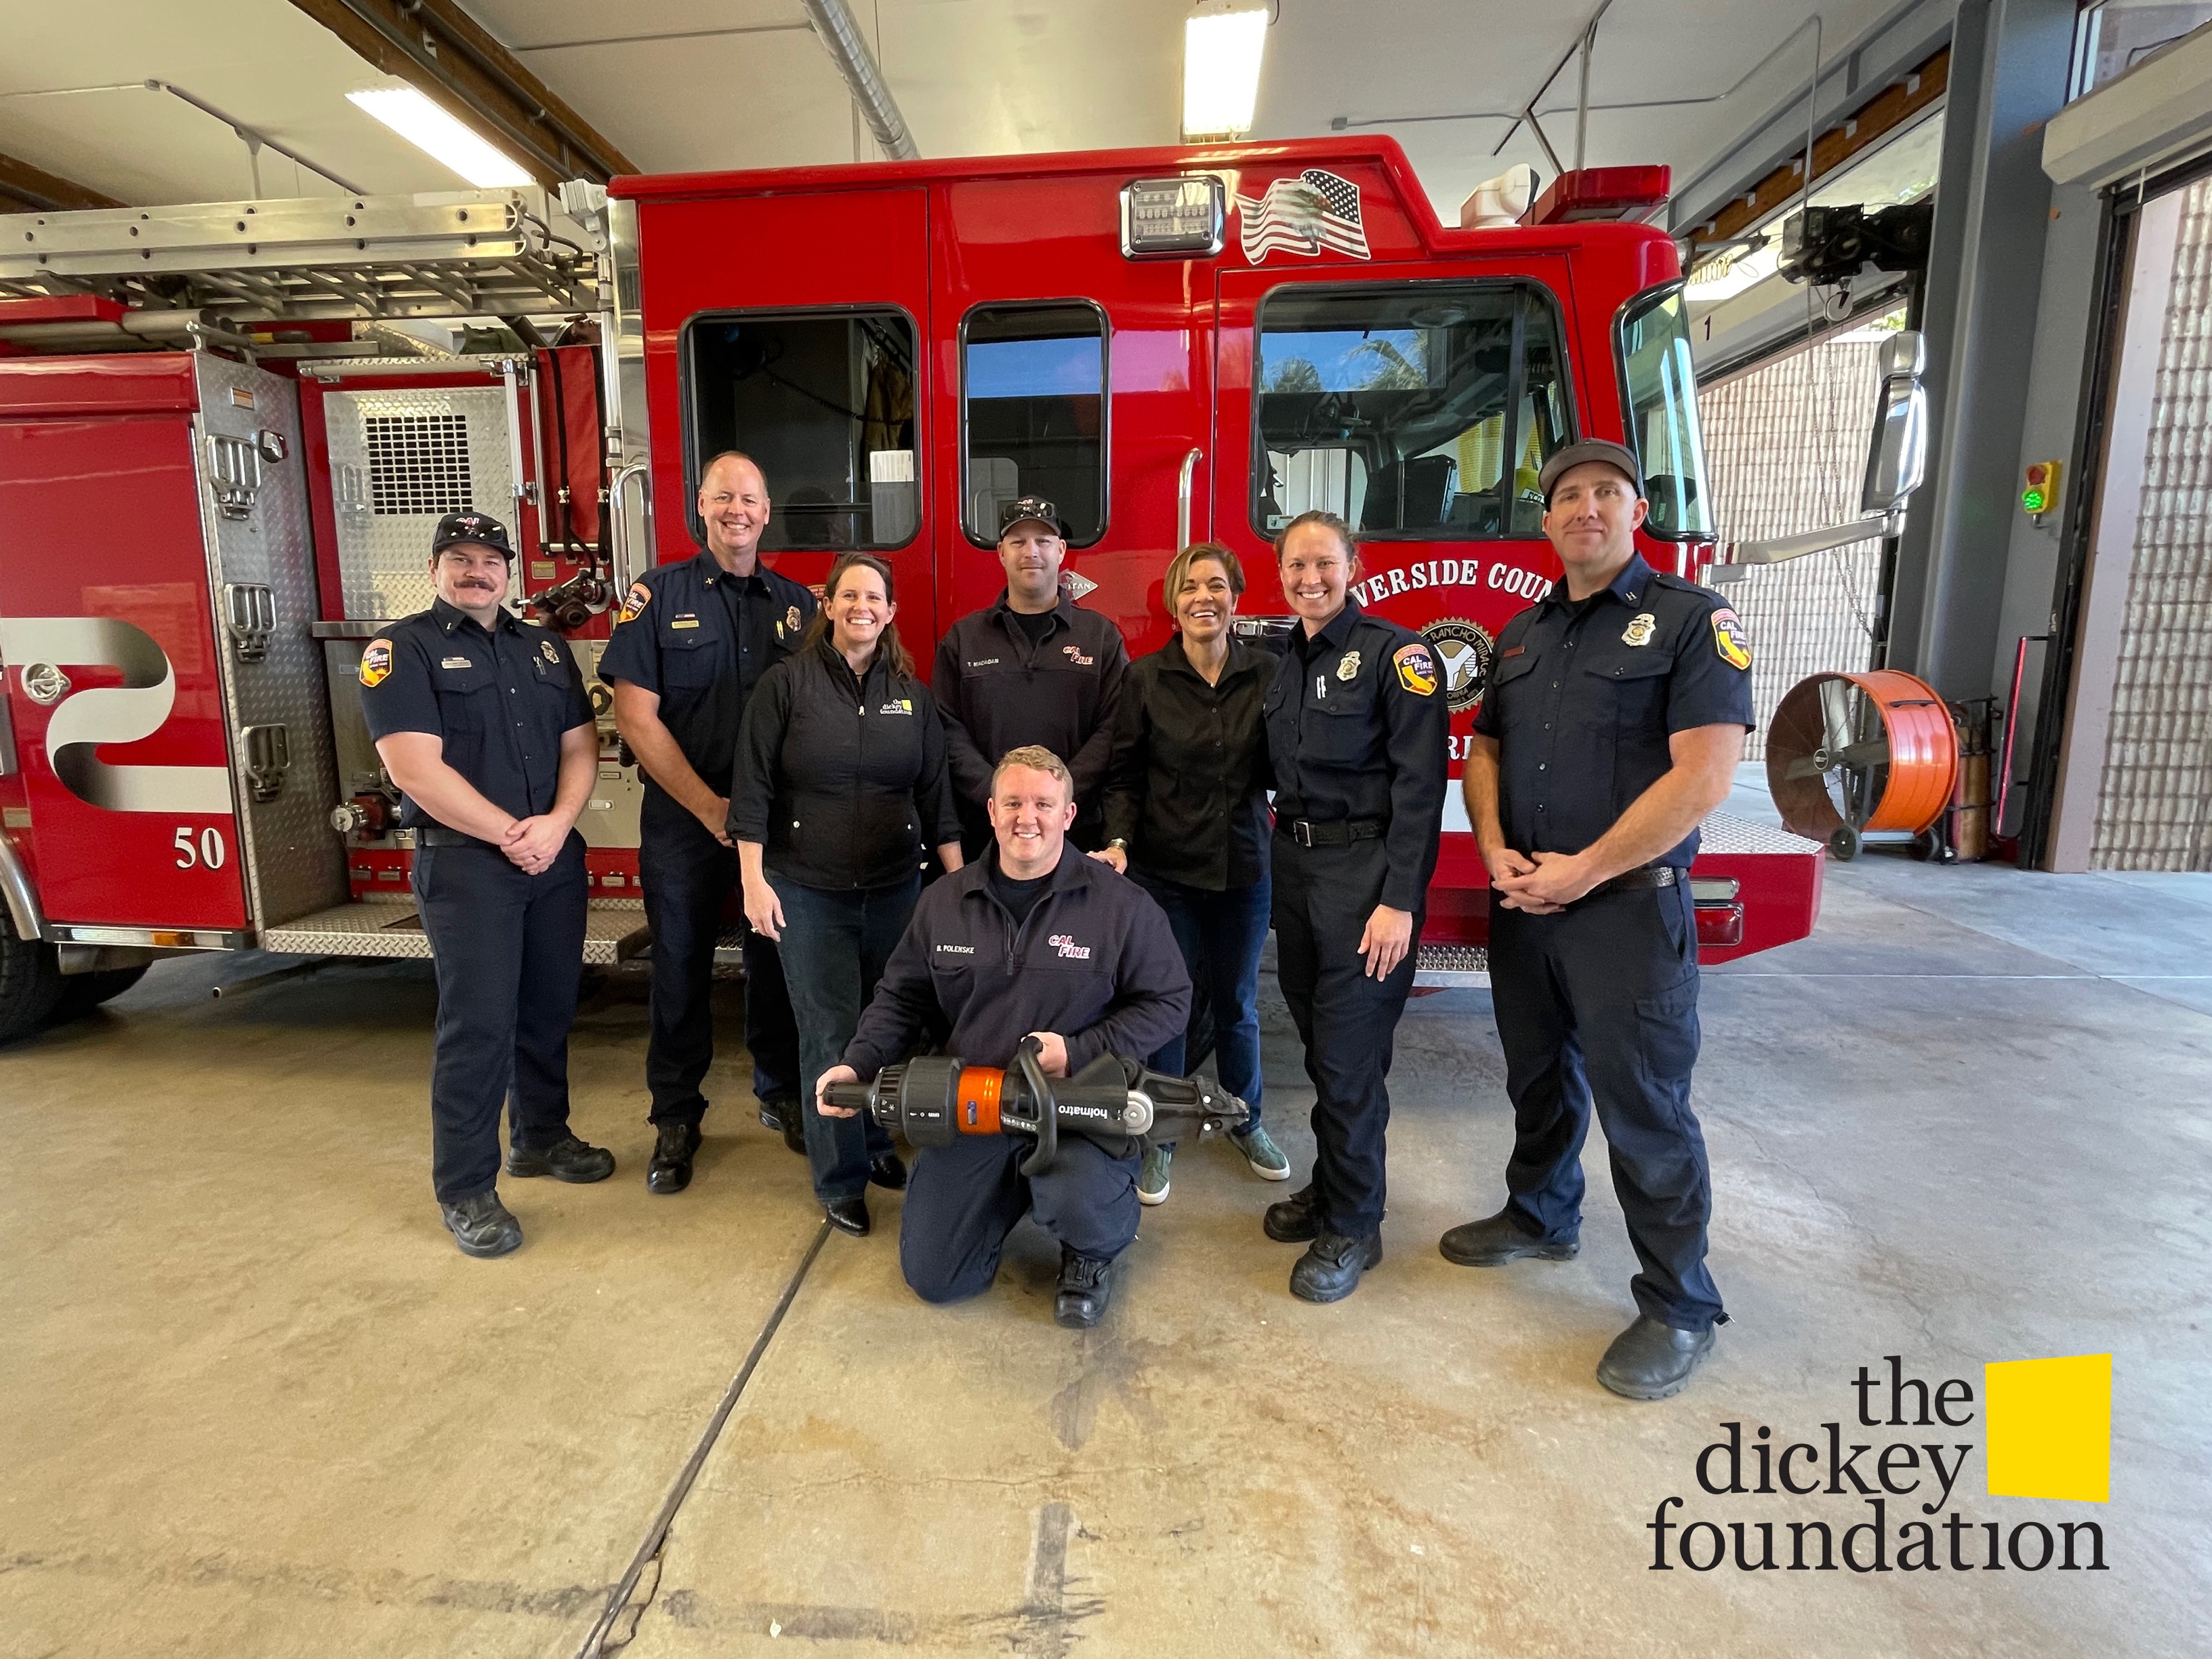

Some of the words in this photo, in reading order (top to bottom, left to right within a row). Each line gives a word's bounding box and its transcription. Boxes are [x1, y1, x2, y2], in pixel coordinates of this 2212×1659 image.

[1704, 314, 1711, 341] 1
[1068, 582, 1091, 590] ITAN
[1349, 559, 1479, 608] VERSIDE
[1488, 562, 1553, 603] COUN
[1719, 621, 1738, 631] CAL
[1429, 626, 1476, 642] RANCHO
[1402, 655, 1422, 665] CAL
[1414, 661, 1433, 671] FIRE
[174, 826, 225, 869] 50
[1048, 935, 1075, 947] CAL
[943, 945, 975, 954] POLENSKE
[1058, 946, 1090, 959] FIRE
[1058, 1105, 1108, 1120] holmatro
